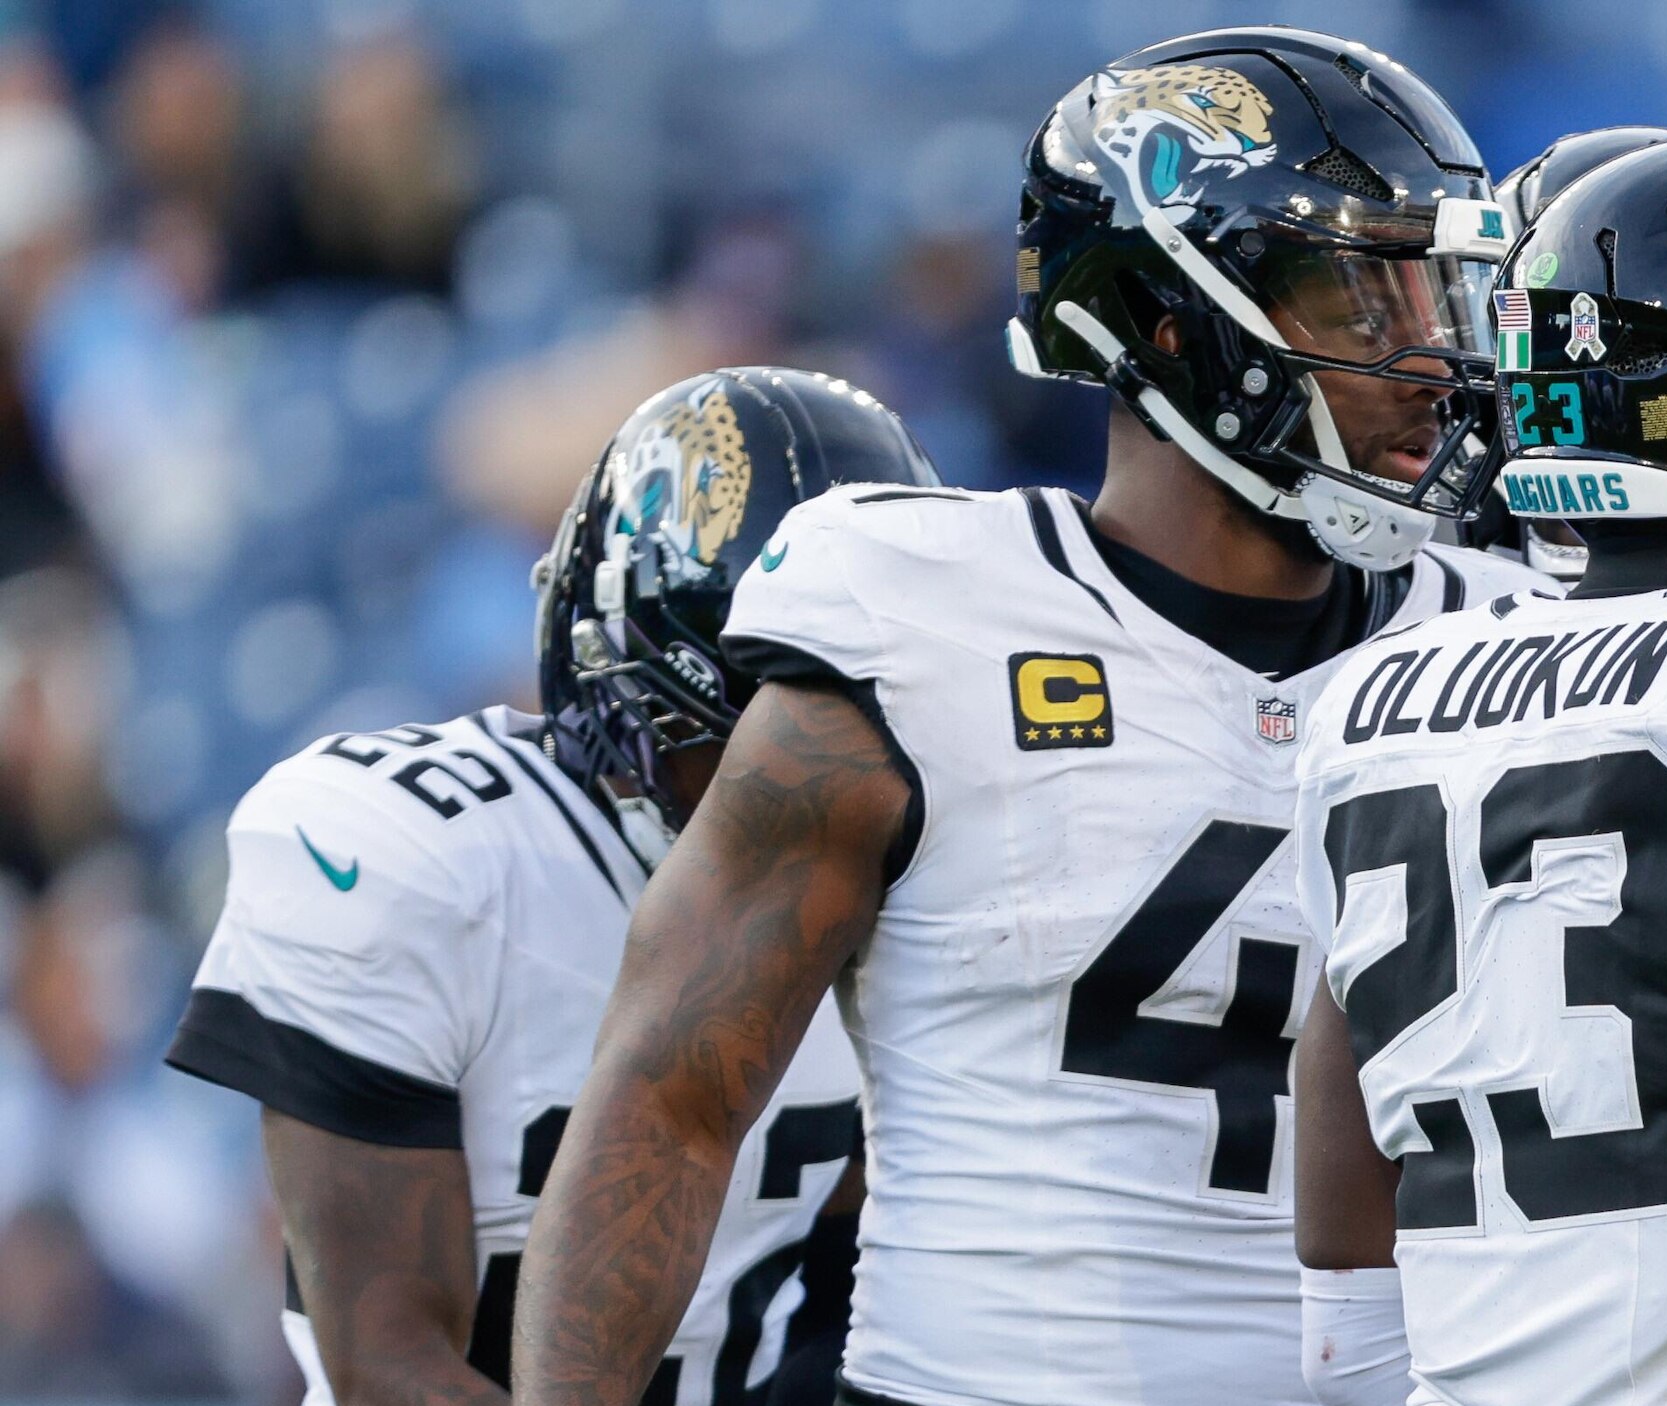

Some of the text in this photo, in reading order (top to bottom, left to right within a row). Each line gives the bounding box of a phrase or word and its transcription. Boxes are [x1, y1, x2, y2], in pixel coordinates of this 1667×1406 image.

[1477, 209, 1504, 239] JAX
[1576, 324, 1594, 339] NFL
[1512, 382, 1584, 445] 23
[1017, 658, 1105, 723] C
[1259, 714, 1293, 738] NFL
[1062, 820, 1306, 1193] 4
